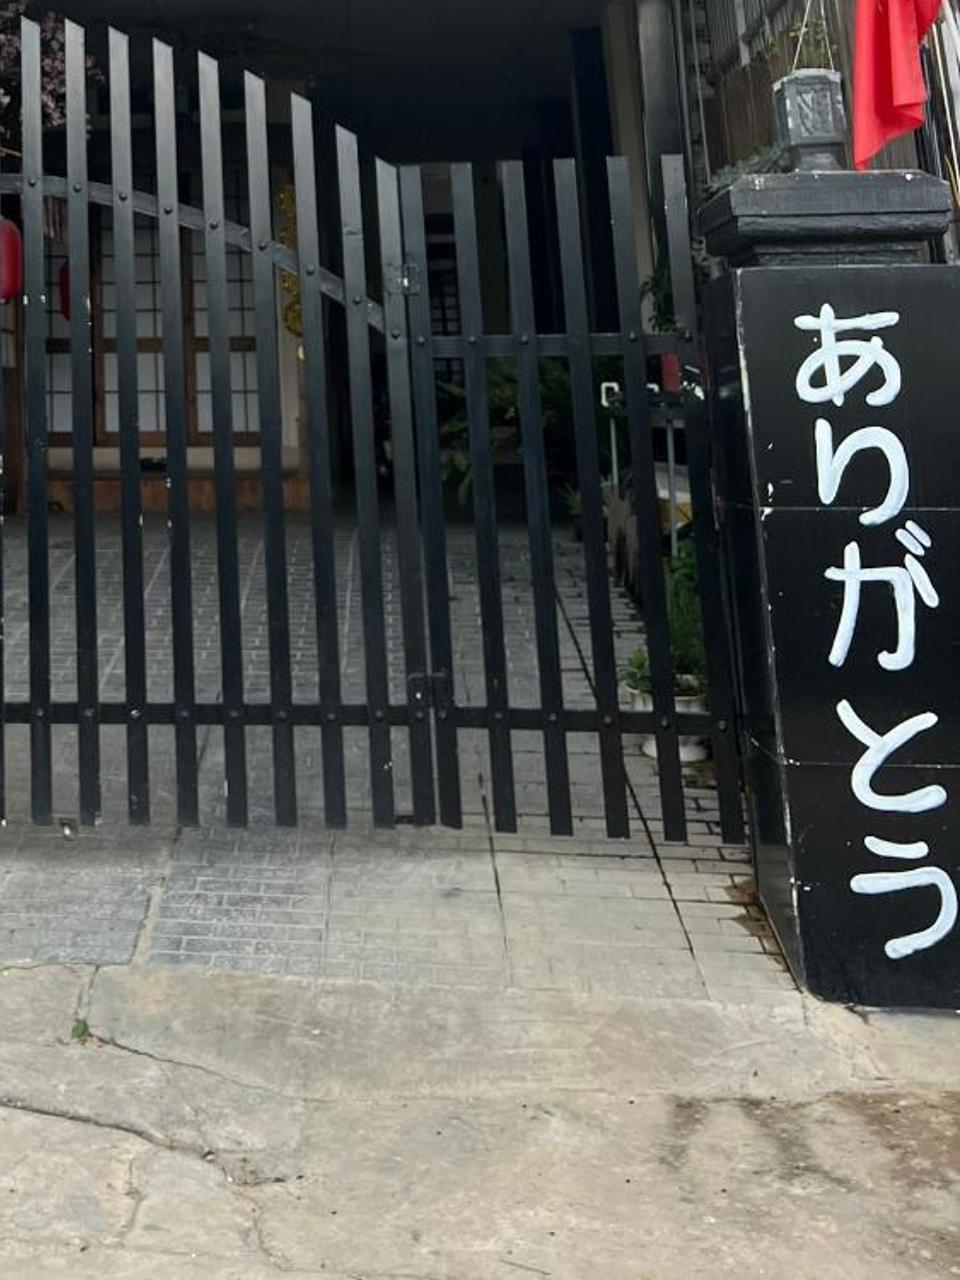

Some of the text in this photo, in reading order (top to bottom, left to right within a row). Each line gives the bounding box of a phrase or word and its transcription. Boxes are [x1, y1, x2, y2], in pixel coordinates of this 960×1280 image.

[794, 303, 958, 959] ありがとう
